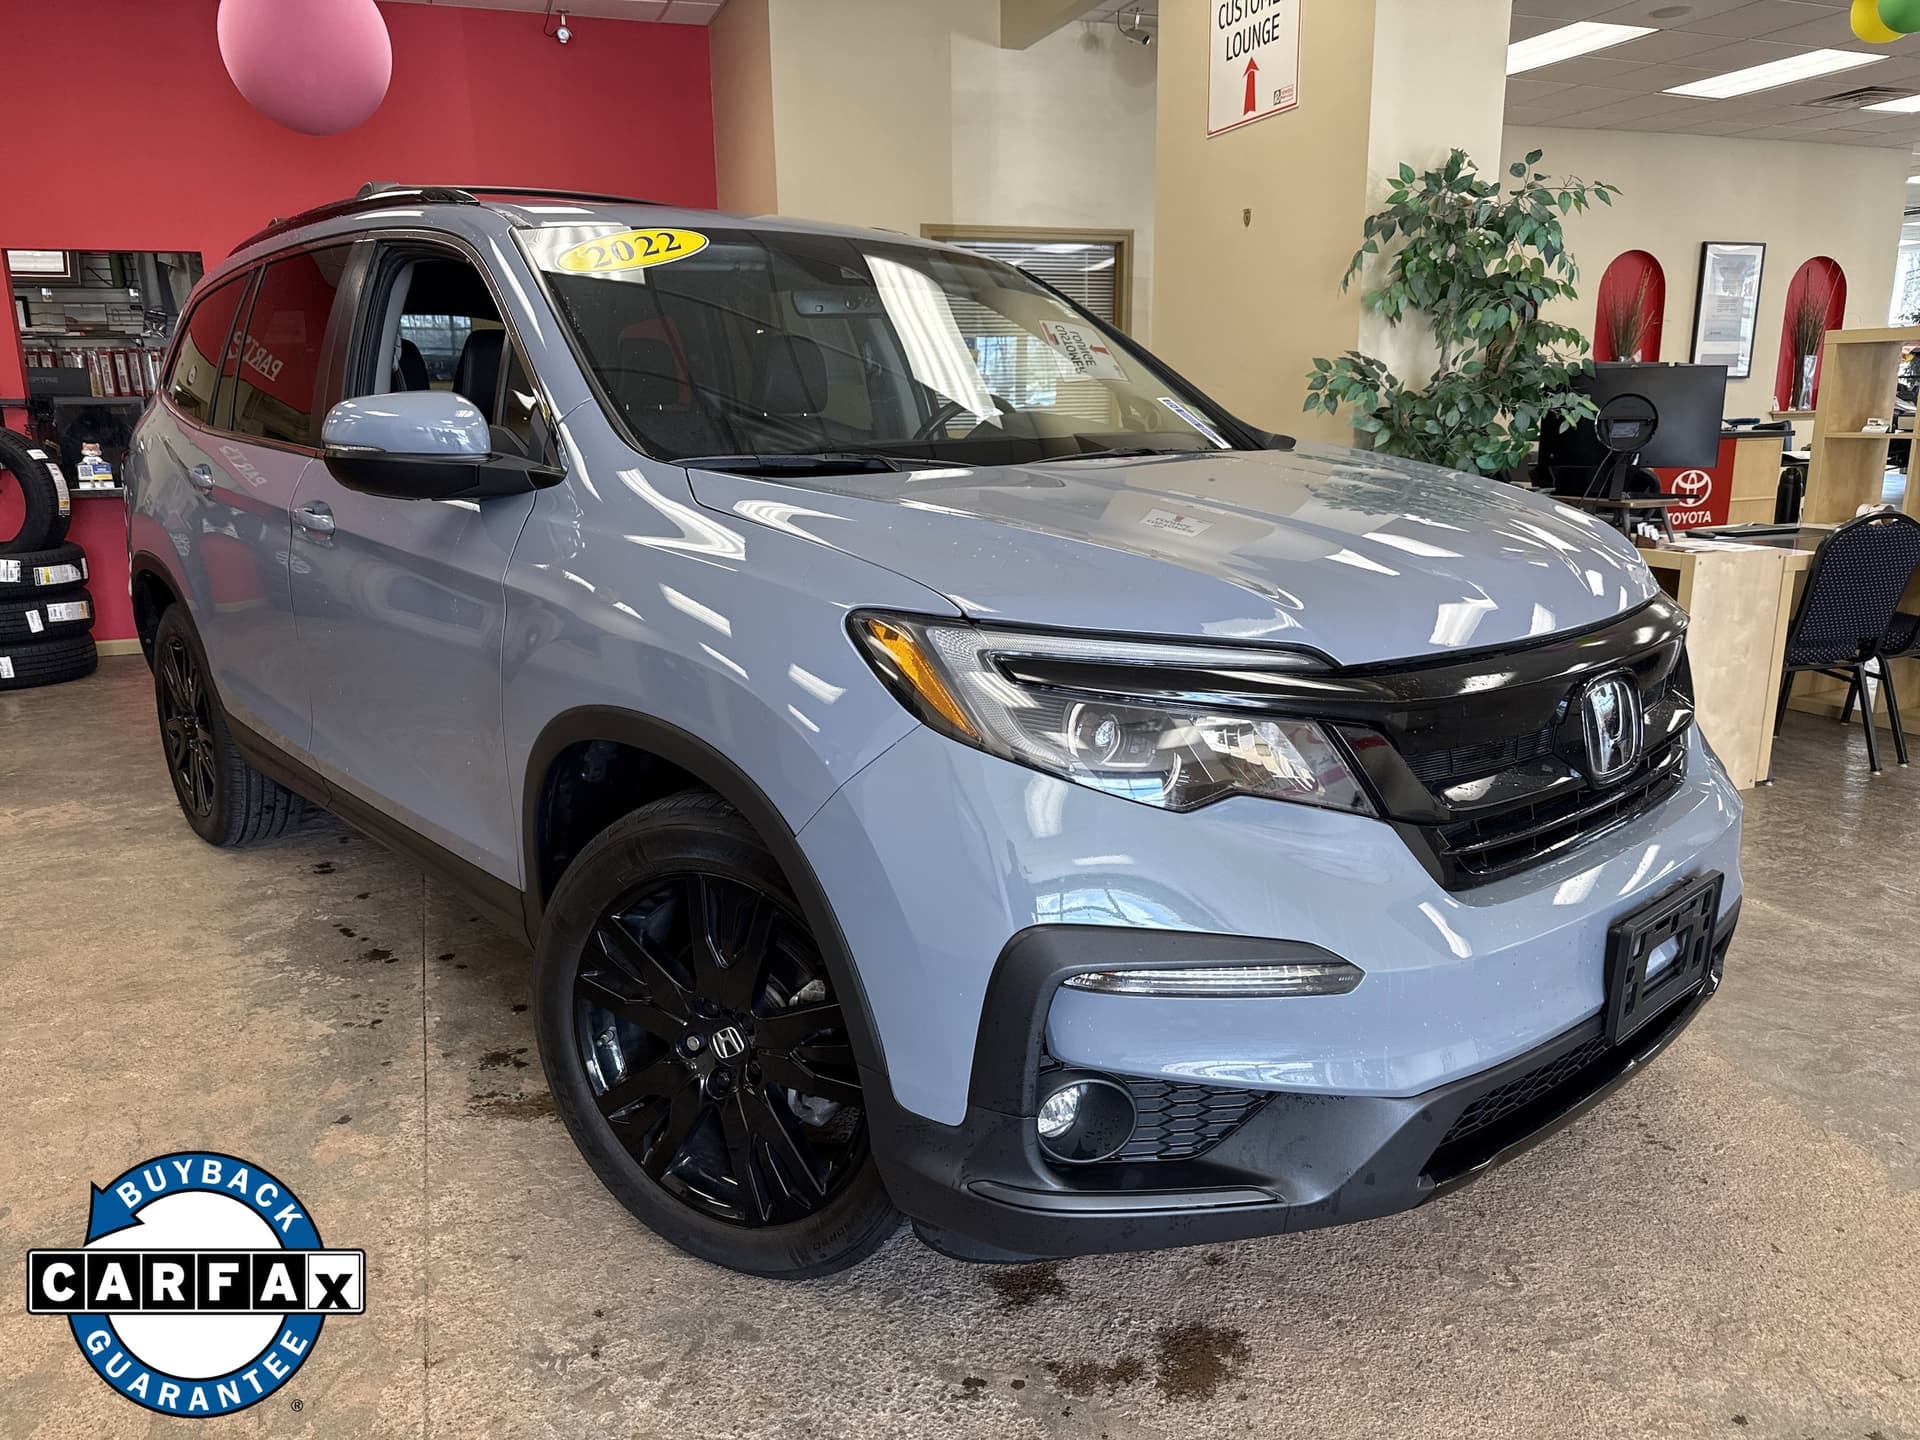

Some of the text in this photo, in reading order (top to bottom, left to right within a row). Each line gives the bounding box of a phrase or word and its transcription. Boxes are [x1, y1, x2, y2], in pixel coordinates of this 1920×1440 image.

[1218, 0, 1281, 30] CUSTO
[1226, 13, 1280, 61] LOUNGE
[585, 232, 681, 268] 2022
[1667, 511, 1712, 525] TOYOTA
